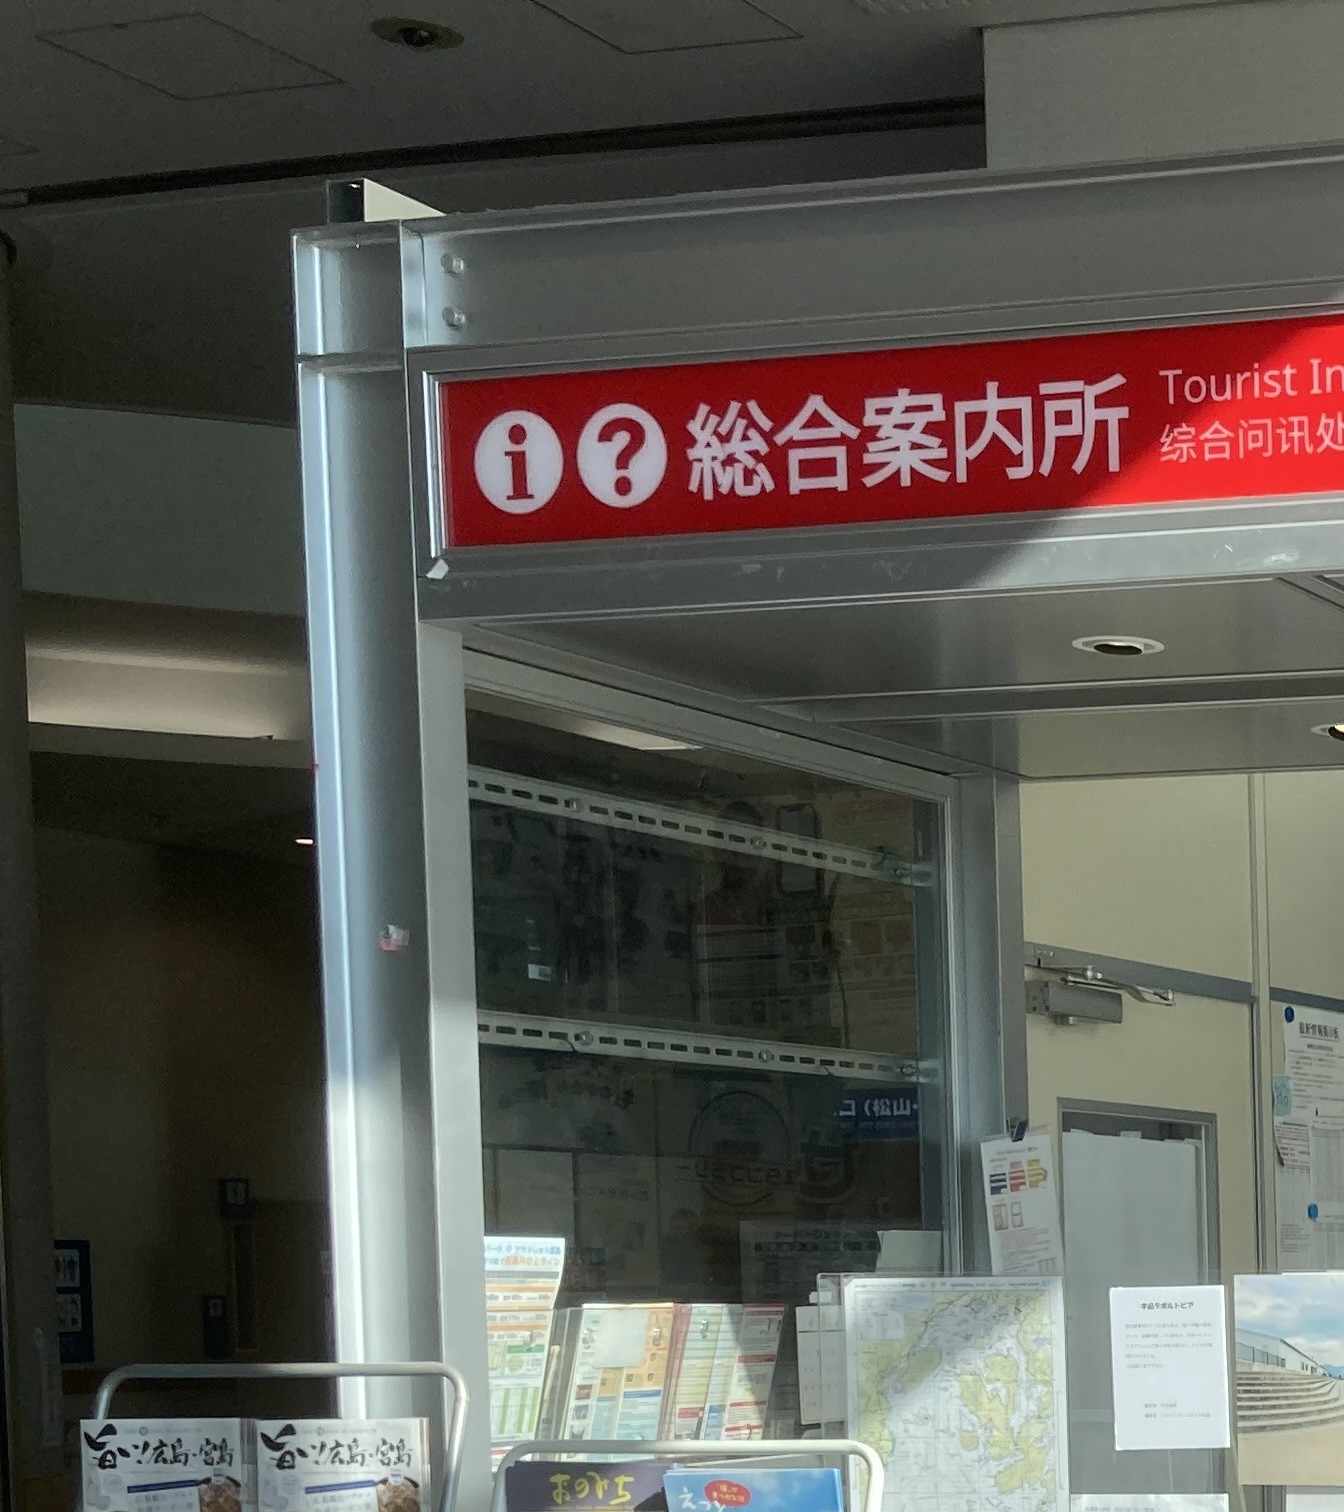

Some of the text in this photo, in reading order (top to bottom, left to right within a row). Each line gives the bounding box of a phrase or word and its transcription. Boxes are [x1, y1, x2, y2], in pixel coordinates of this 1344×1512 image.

[1160, 364, 1297, 404] Tourist
[687, 373, 1129, 501] 総合案内所
